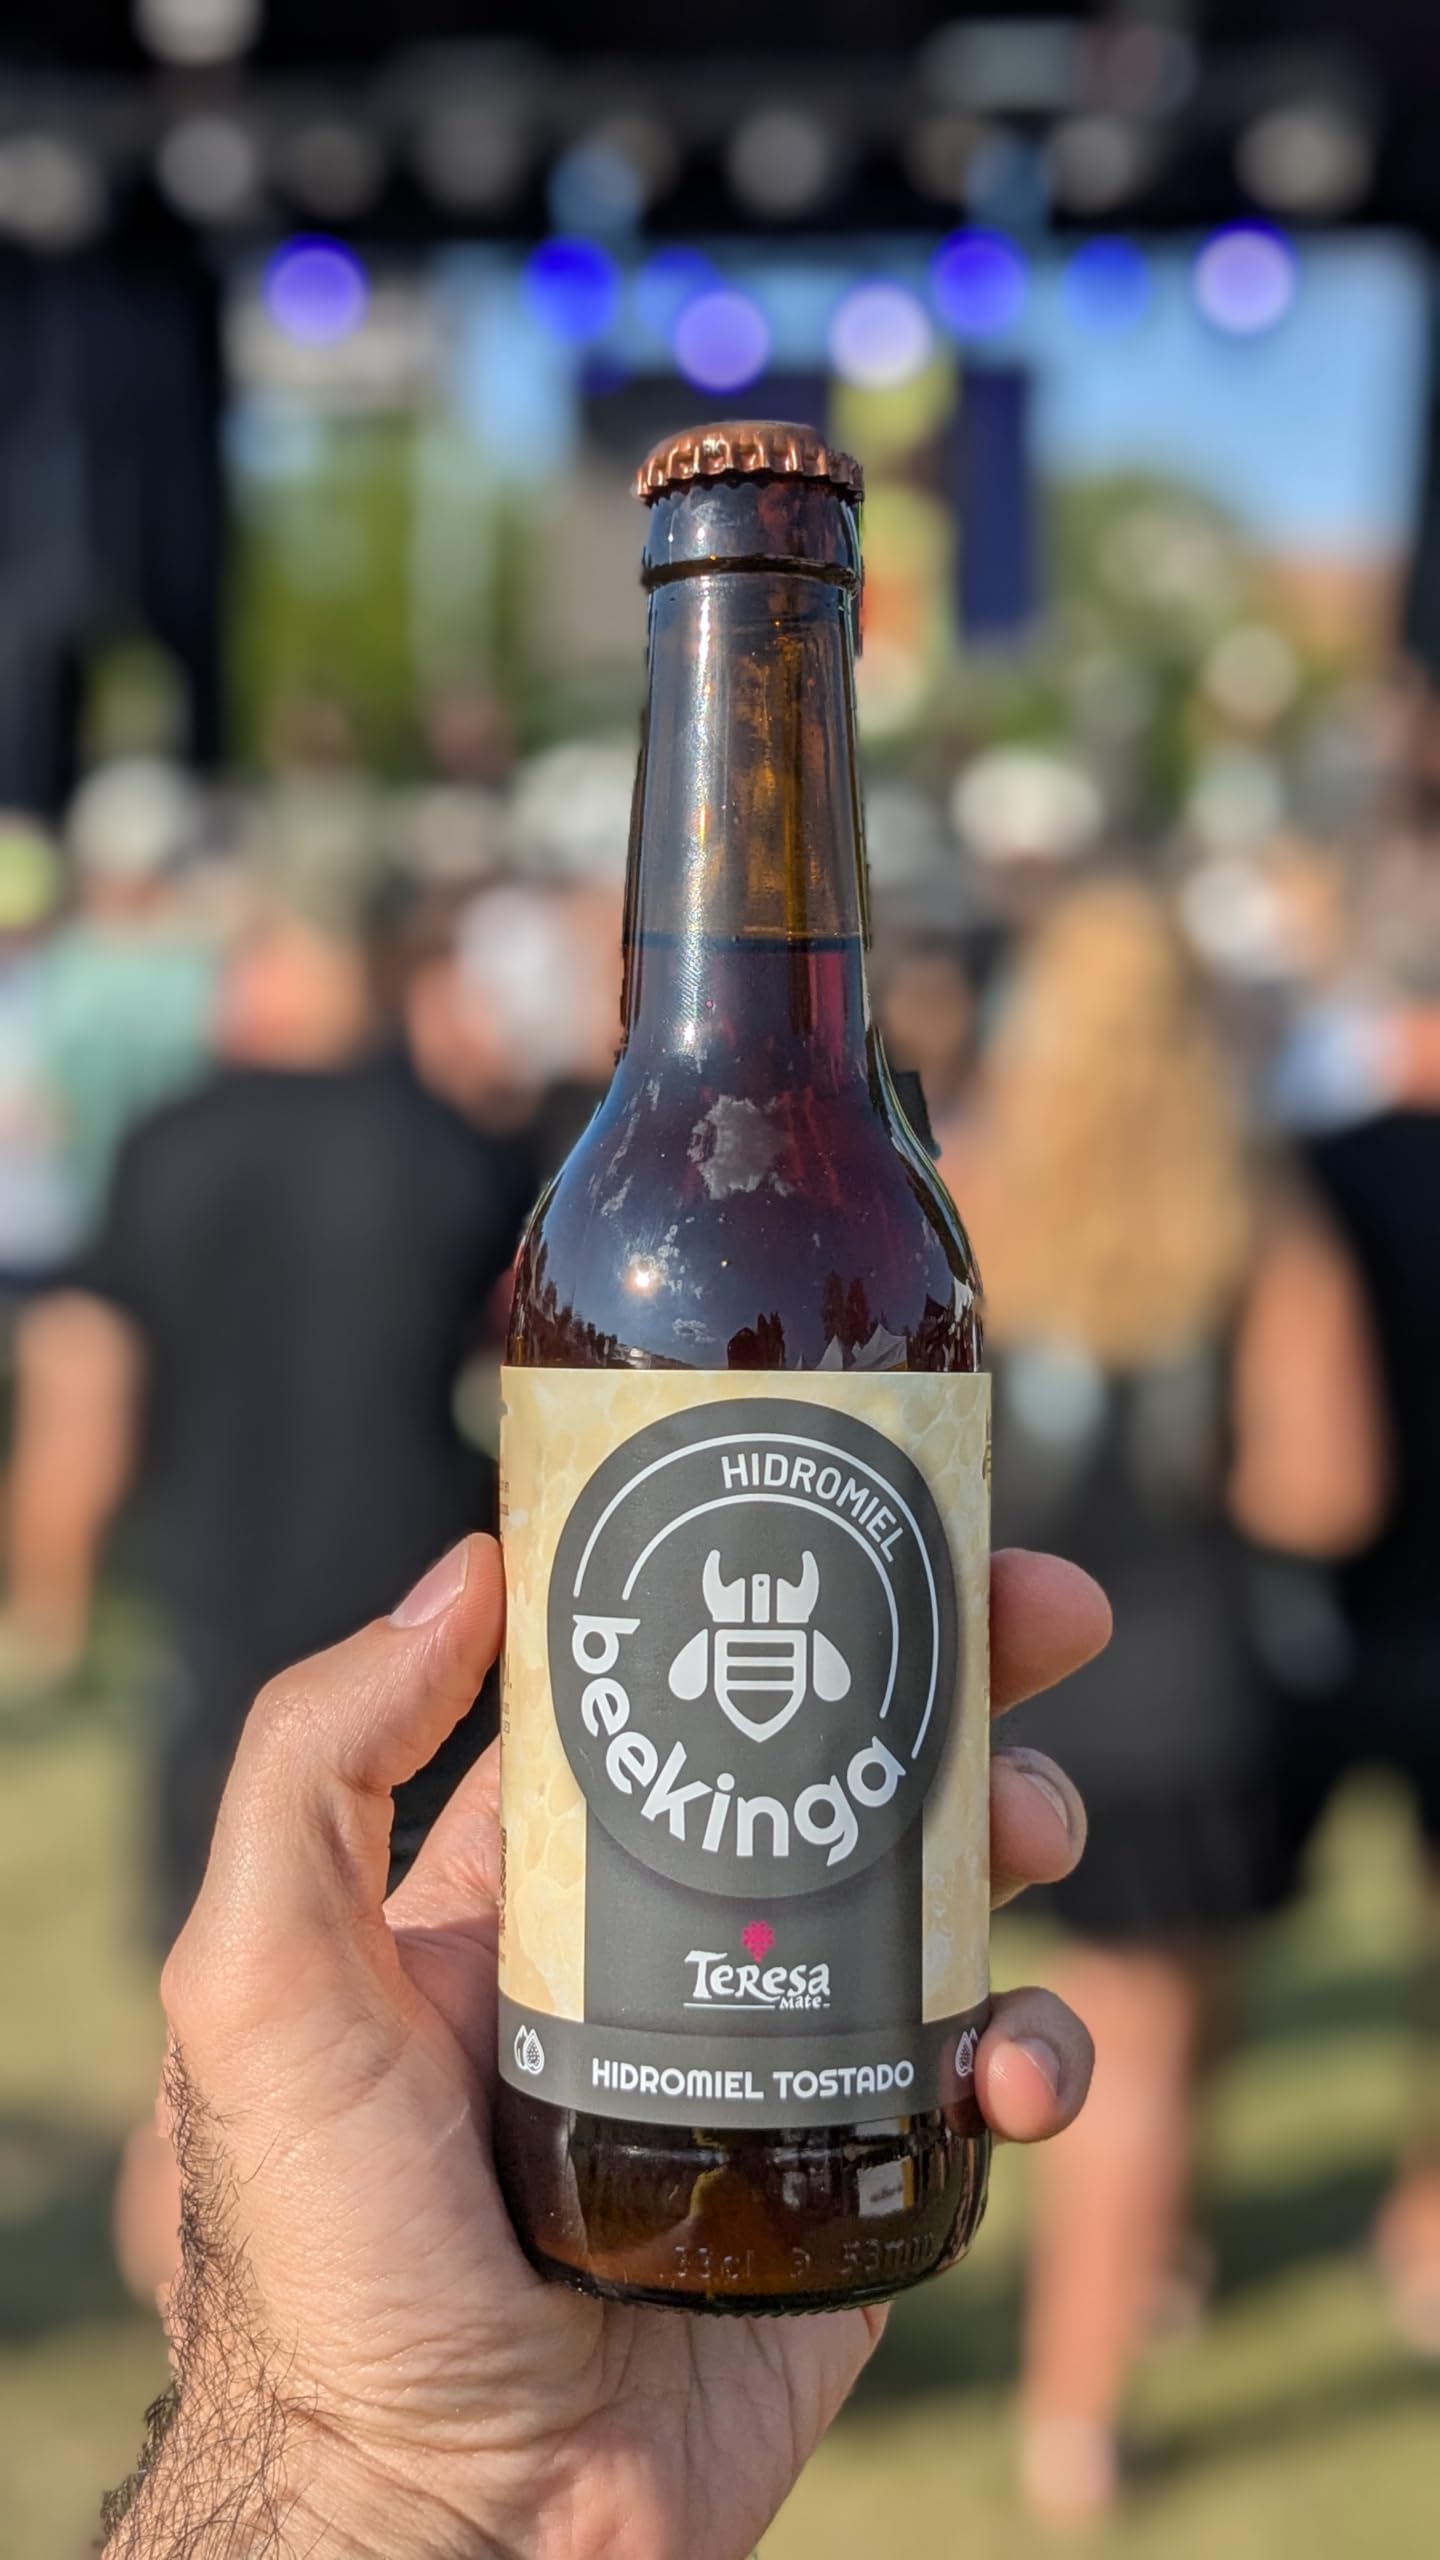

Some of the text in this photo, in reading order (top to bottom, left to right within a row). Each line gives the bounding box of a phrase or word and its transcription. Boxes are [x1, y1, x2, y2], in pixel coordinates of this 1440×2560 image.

[721, 1453, 905, 1563] HIDROMIEL
[571, 1613, 906, 1867] beekinga
[591, 2057, 915, 2100] HIDROMIEL TOSTADO
